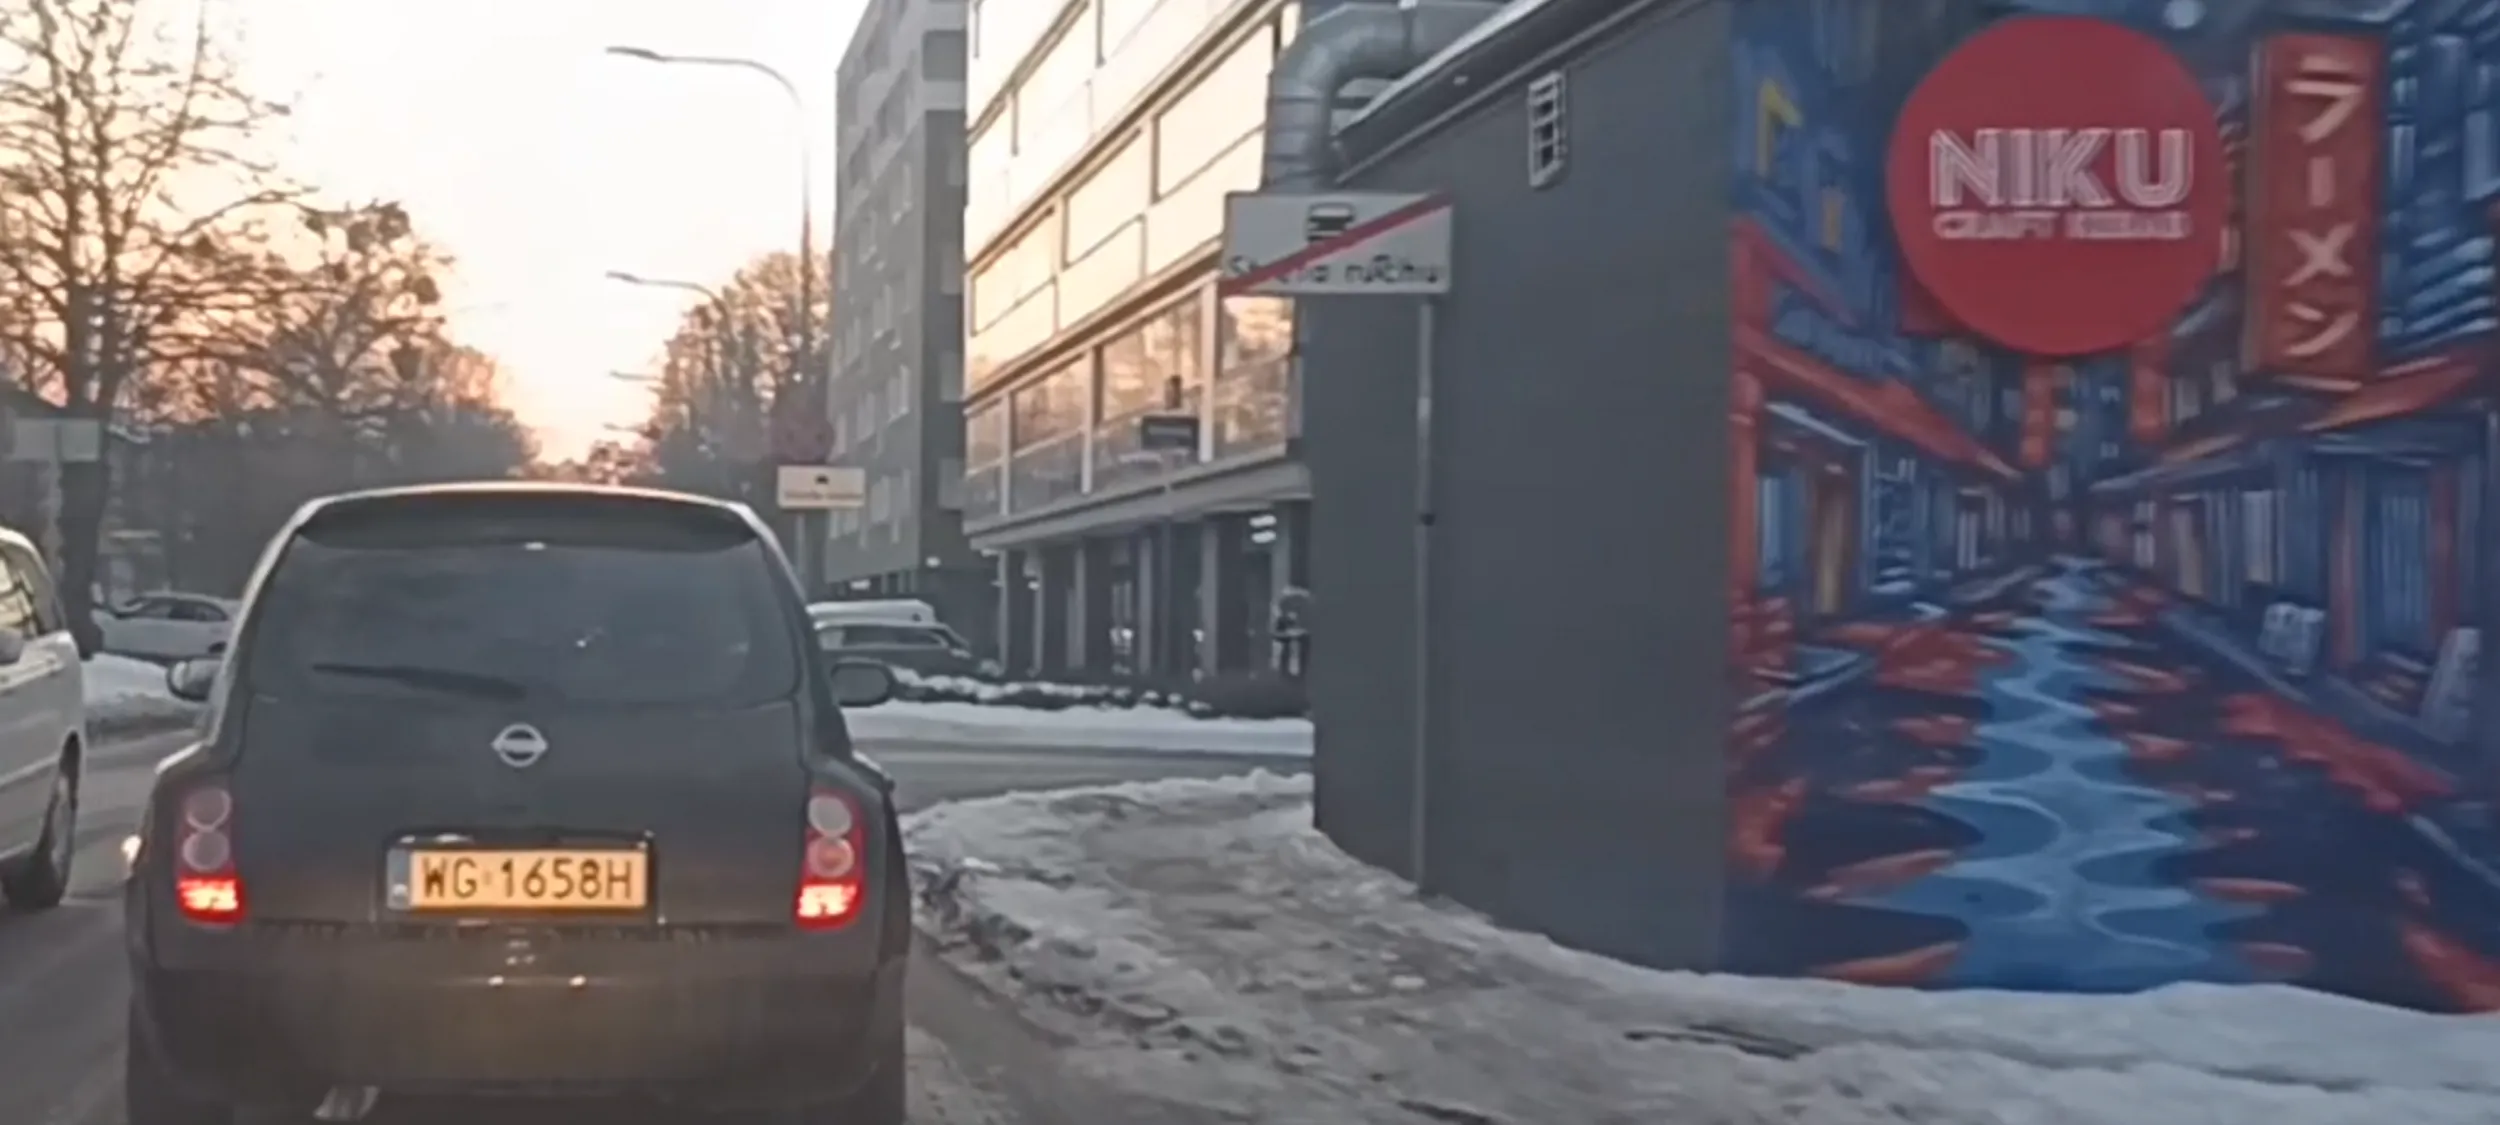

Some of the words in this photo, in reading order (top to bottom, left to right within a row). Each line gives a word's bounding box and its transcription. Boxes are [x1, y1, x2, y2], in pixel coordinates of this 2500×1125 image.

[1929, 127, 2194, 207] NIKU
[2284, 55, 2364, 357] ラーメン
[421, 857, 477, 898] WG
[501, 857, 632, 899] 1658H
